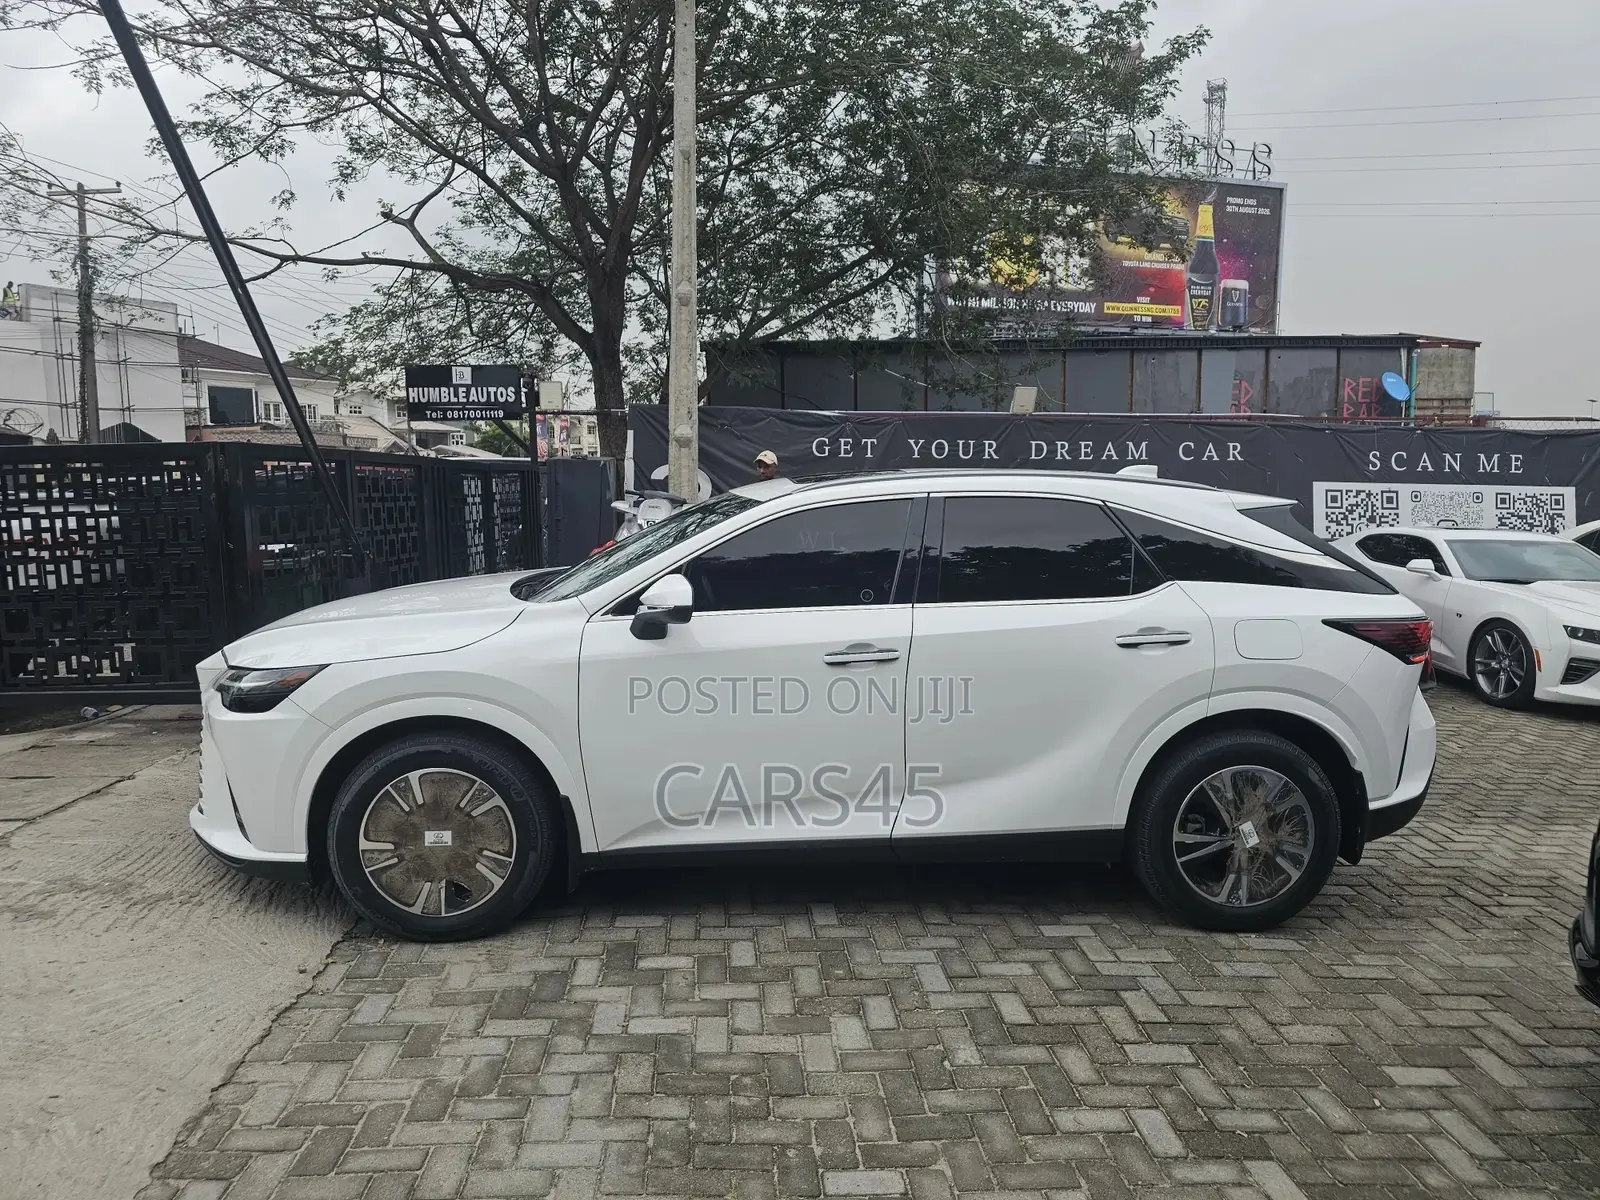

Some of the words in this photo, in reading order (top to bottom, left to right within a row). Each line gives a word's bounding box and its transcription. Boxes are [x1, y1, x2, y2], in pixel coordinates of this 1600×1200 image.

[1226, 196, 1243, 205] PROMO
[1244, 198, 1257, 206] ENDS
[1239, 206, 1257, 214] AUGUST
[1050, 300, 1097, 314] EVERYDAY
[408, 386, 467, 403] HUMBLE
[468, 386, 516, 403] AUTOS
[425, 410, 444, 419] Tel:
[811, 437, 878, 459] GET
[907, 438, 1000, 460] YOUR
[1030, 440, 1149, 461] DREAM
[1178, 441, 1246, 462] CAR
[1368, 450, 1463, 473] SCAN
[1477, 452, 1524, 474] ME
